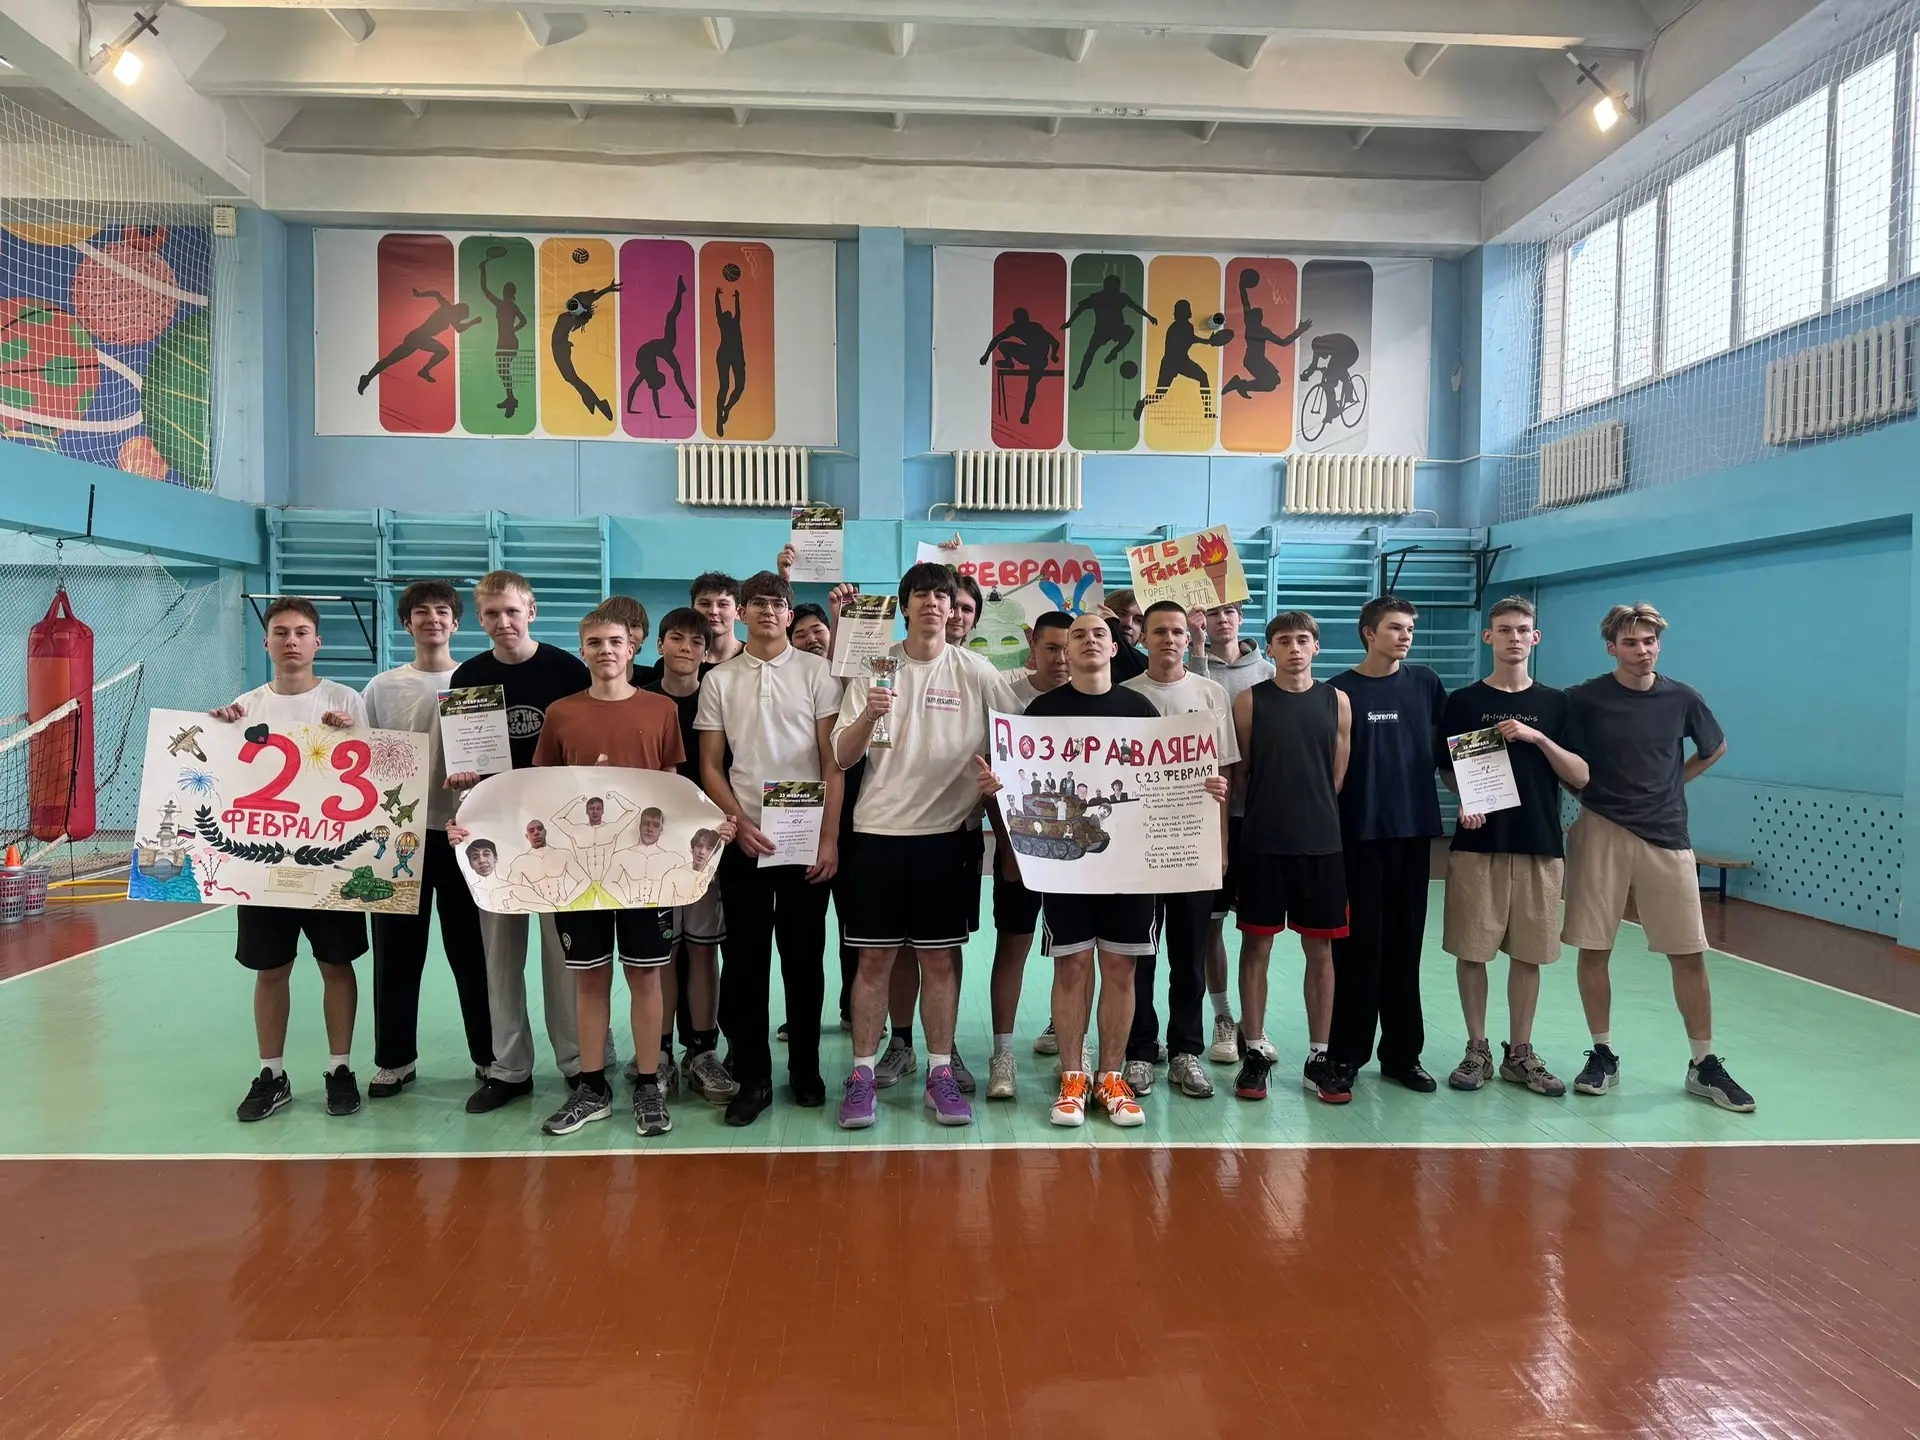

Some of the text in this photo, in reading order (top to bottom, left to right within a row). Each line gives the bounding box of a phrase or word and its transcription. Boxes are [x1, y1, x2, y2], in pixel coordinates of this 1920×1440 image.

[958, 559, 1102, 586] ФЕВРАЛЯ
[520, 709, 539, 722] THE
[1368, 712, 1398, 722] Supreme
[995, 718, 1218, 767] ПОЗДРАВЛЯЕМ
[233, 732, 378, 822] 23
[1145, 771, 1160, 783] 23
[1164, 764, 1213, 781] ФЕВРАЛЯ
[222, 809, 346, 842] ФЕВРАЛЯ
